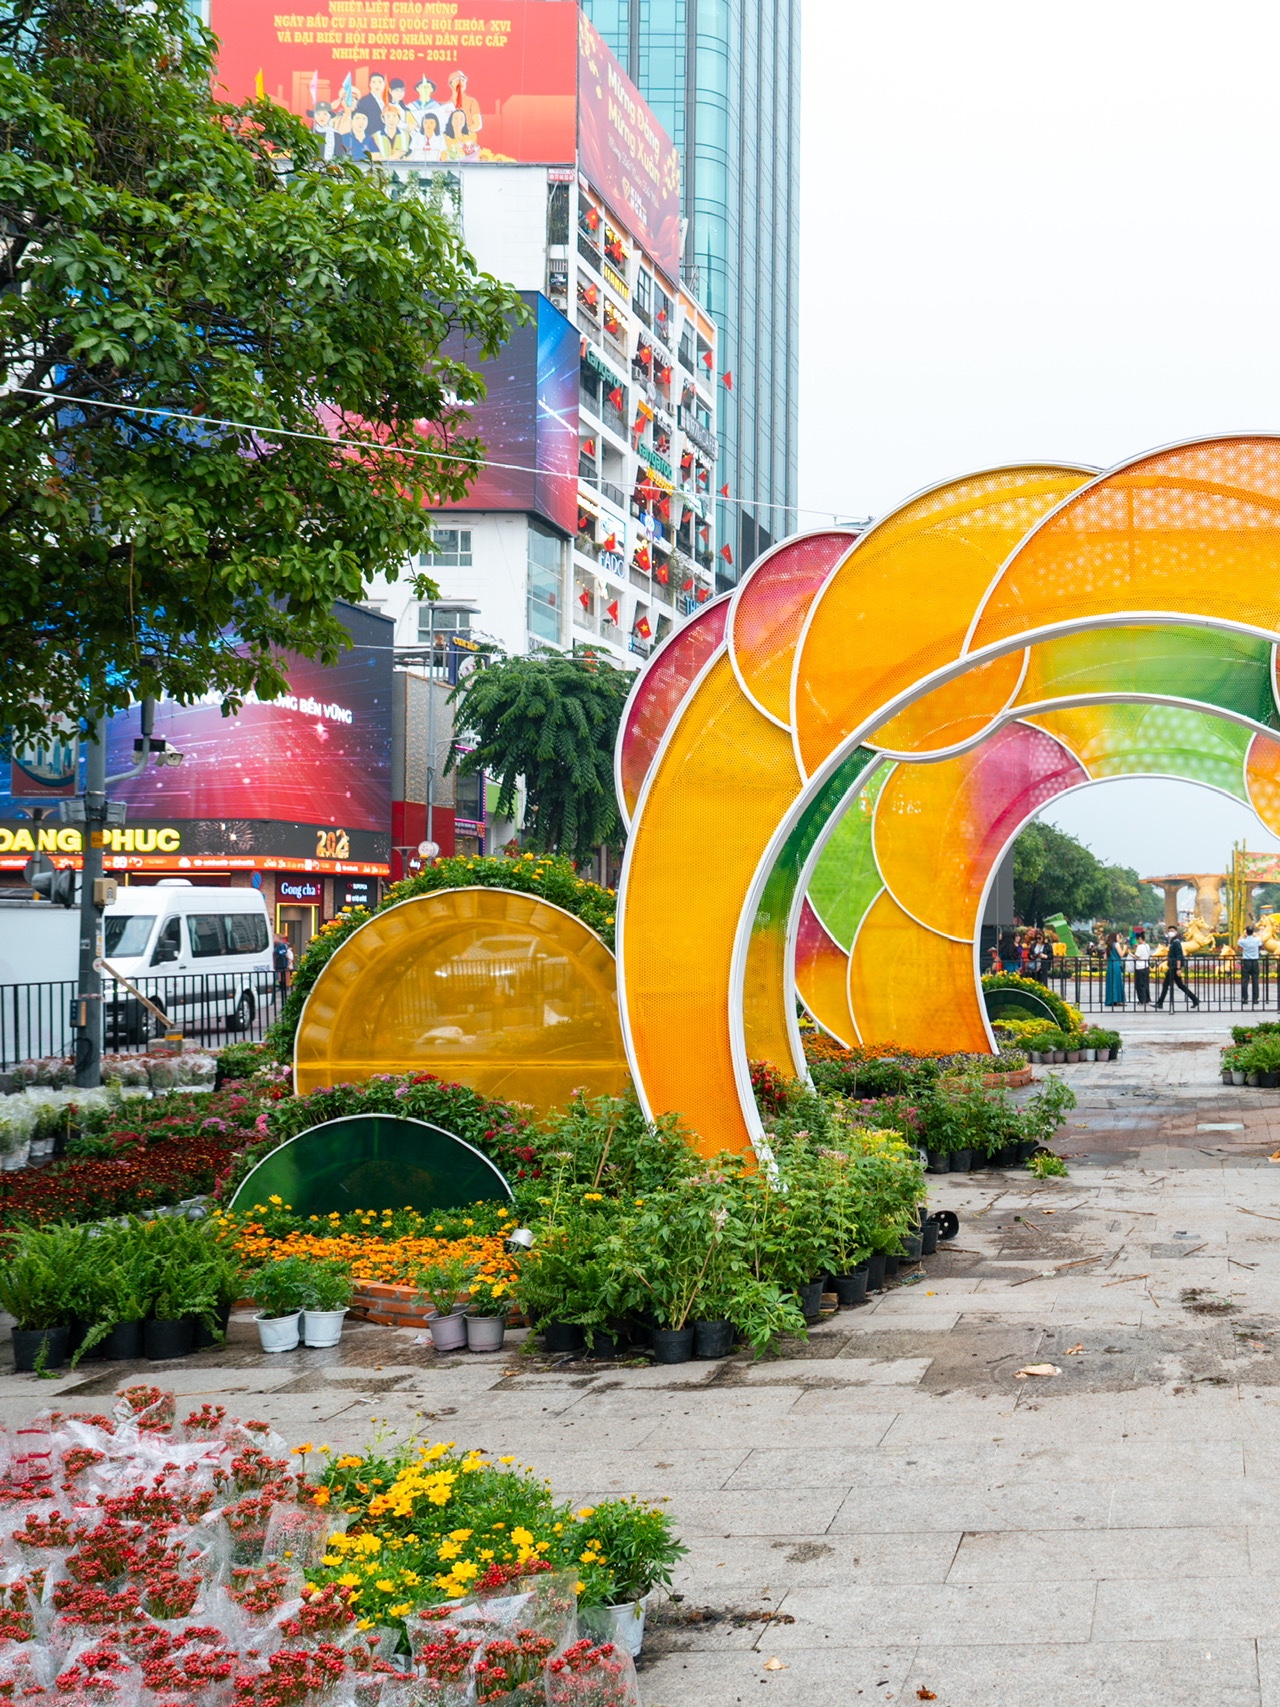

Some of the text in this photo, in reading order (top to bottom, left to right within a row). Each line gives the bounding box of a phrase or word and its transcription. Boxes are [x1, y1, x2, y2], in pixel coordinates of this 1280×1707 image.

[328, 1, 363, 14] NHIỆT
[365, 1, 390, 15] LIỆT
[392, 1, 422, 14] CHÀO
[273, 12, 304, 27] NGÀY
[348, 17, 368, 31] ĐẠI
[431, 18, 452, 33] HỘI
[454, 17, 485, 31] KHÓA
[490, 20, 512, 32] XVI
[276, 29, 292, 43] VÀ
[294, 31, 313, 46] ĐẠI
[344, 31, 366, 47] HỘI
[402, 32, 433, 45] NHÂN
[435, 32, 458, 46] DÂN
[461, 32, 483, 46] CÁC
[332, 45, 370, 62] NHIỆM
[371, 47, 388, 60] KỲ
[390, 49, 415, 61] 2026
[607, 62, 636, 125] Mừng
[607, 96, 636, 158] Mừng
[281, 882, 302, 899] Gong
[302, 883, 316, 896] cha
